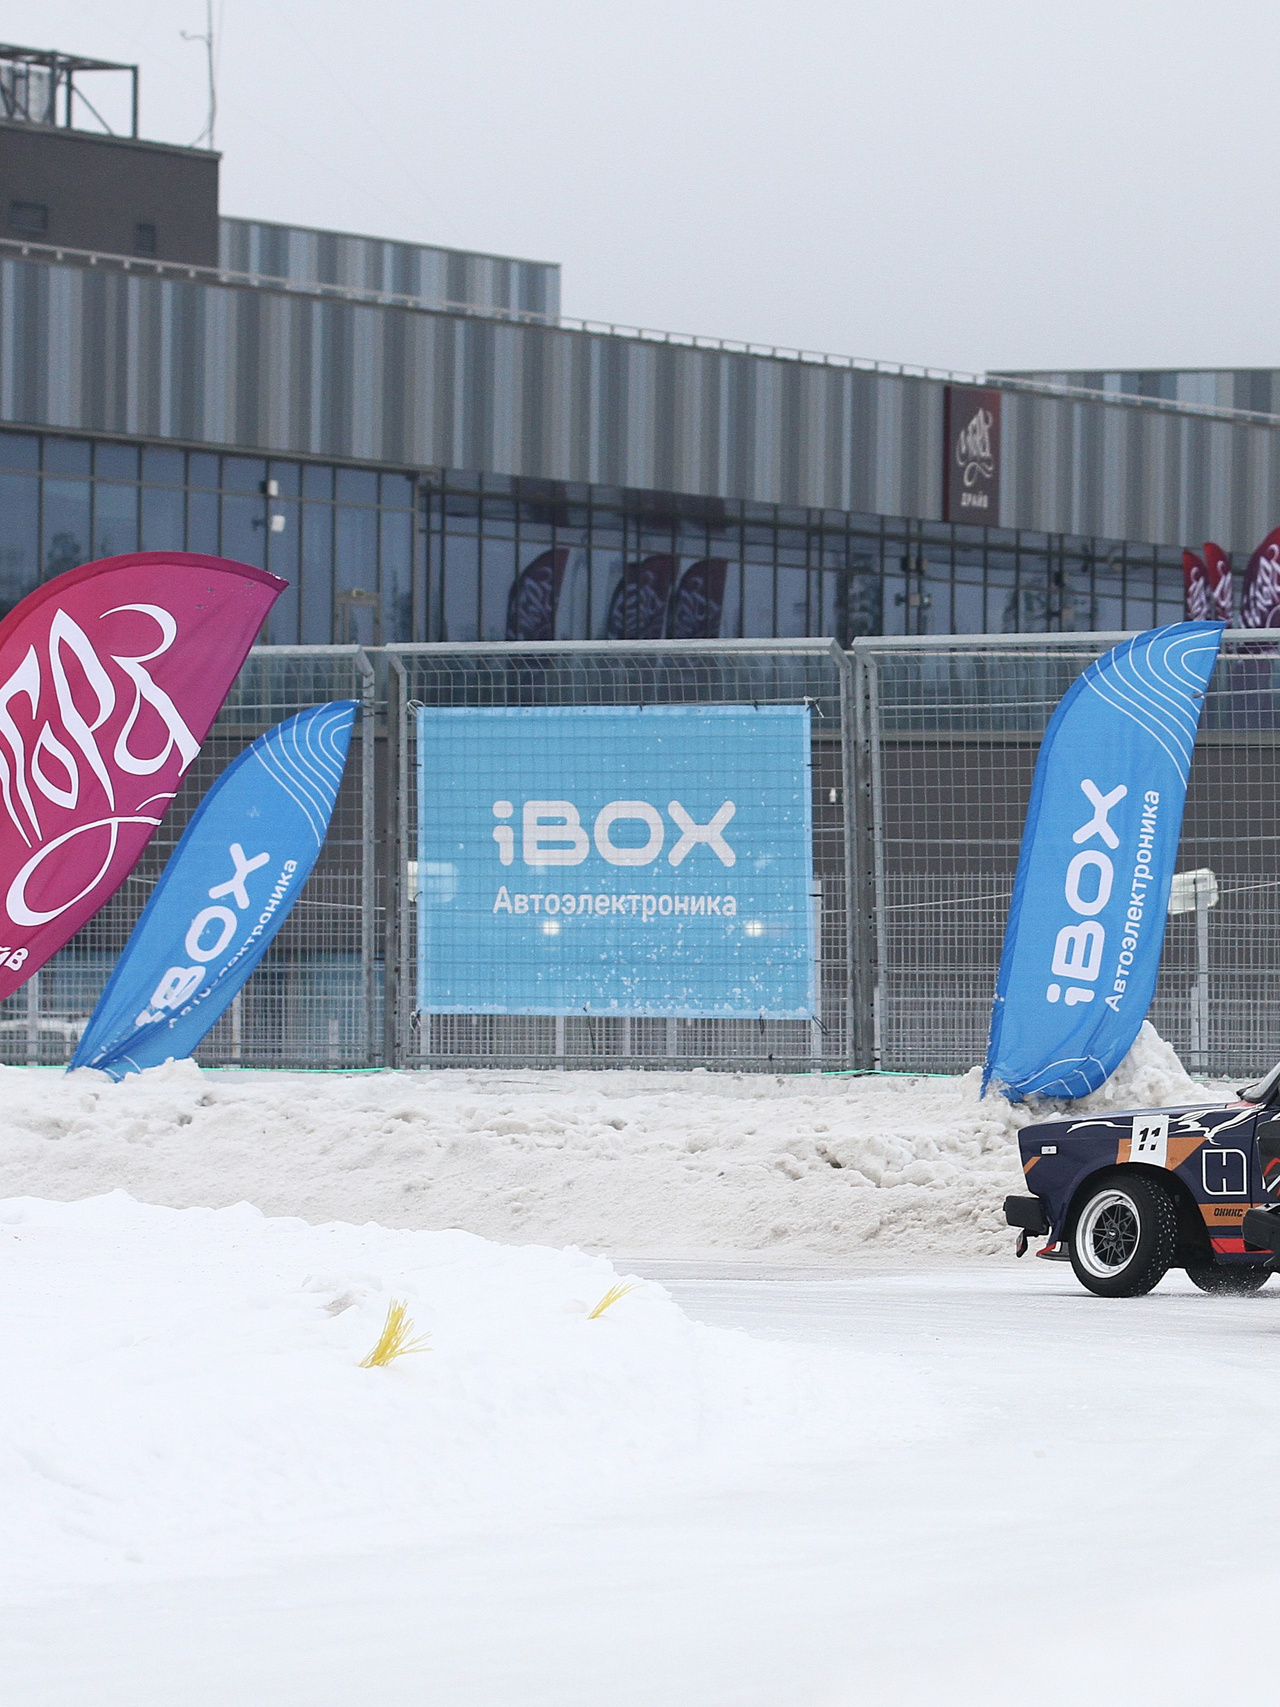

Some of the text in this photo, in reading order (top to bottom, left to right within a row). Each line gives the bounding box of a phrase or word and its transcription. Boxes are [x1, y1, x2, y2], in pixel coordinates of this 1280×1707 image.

[492, 800, 736, 867] iBOX
[492, 886, 738, 923] Автоэлектроника
[1046, 778, 1128, 1006] iBOX
[1104, 789, 1160, 1012] Автоэлектроника
[1138, 1127, 1161, 1151] 11
